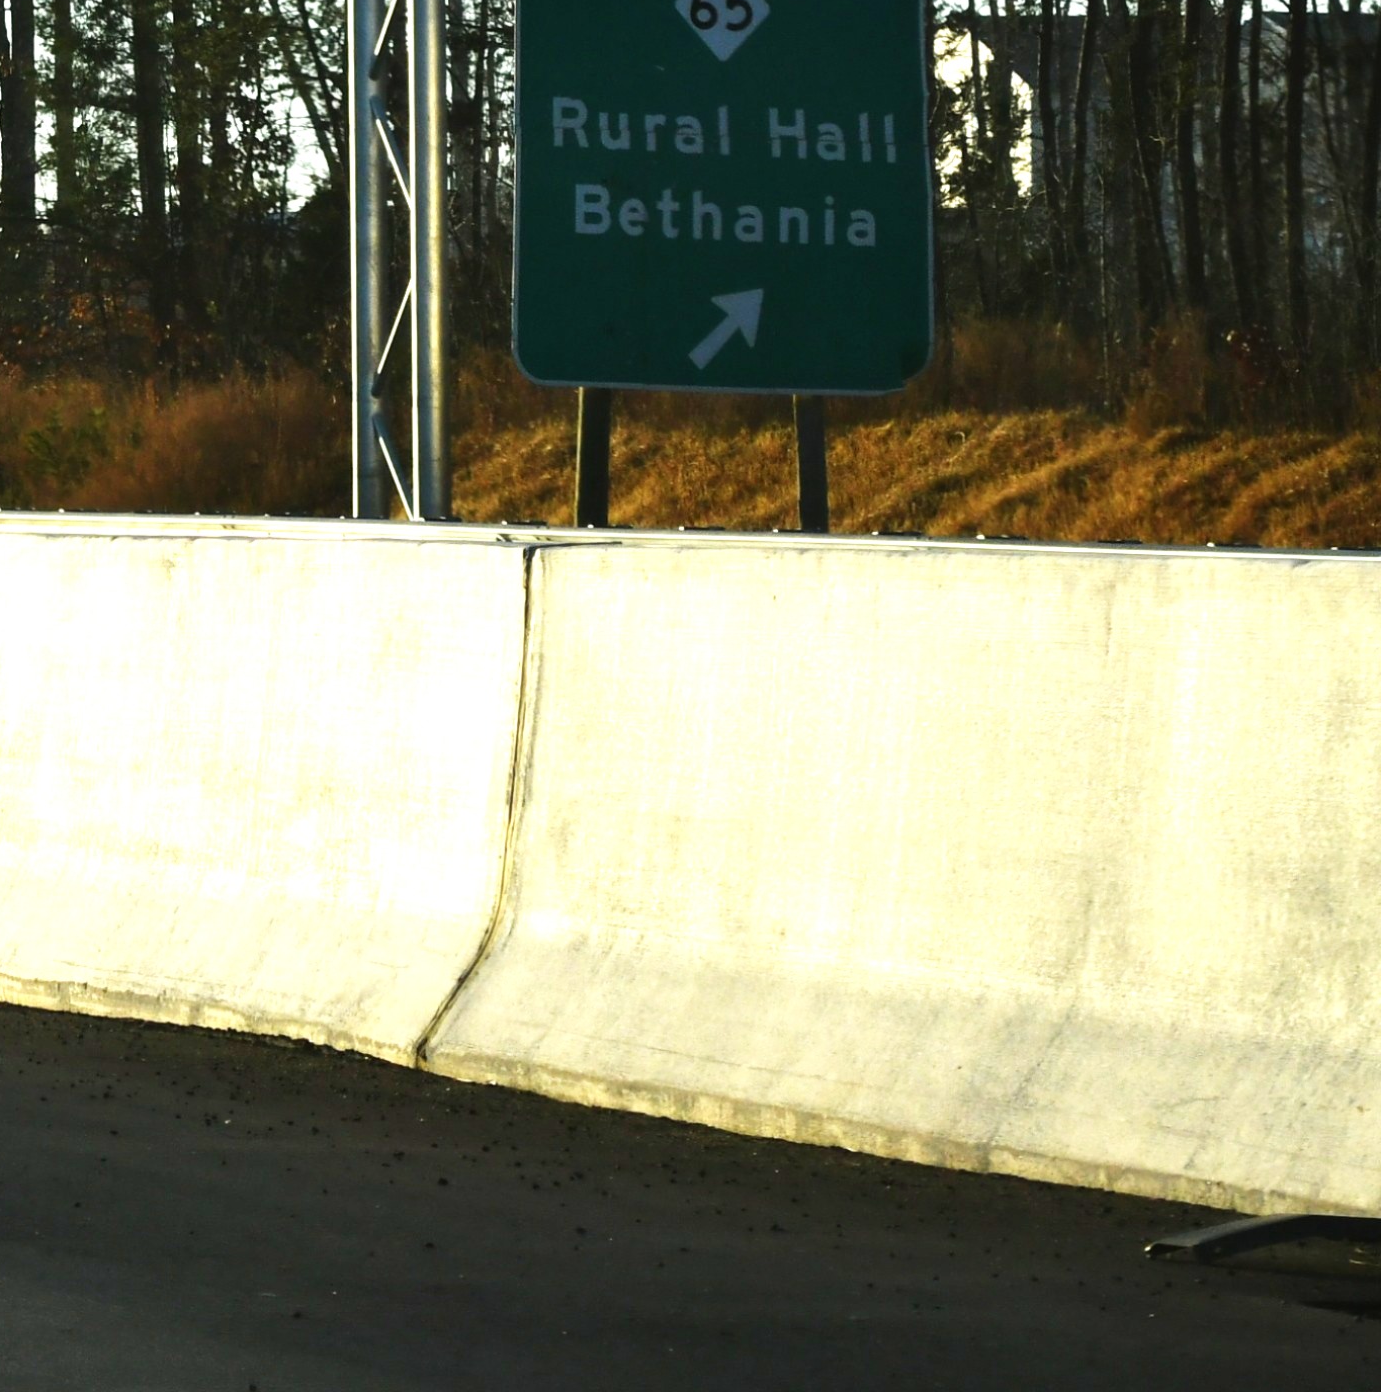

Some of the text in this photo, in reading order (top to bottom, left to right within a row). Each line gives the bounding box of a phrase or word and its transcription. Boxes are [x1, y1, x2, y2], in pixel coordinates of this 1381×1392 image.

[552, 96, 897, 164] Rural Hall
[574, 183, 877, 247] Bethania
